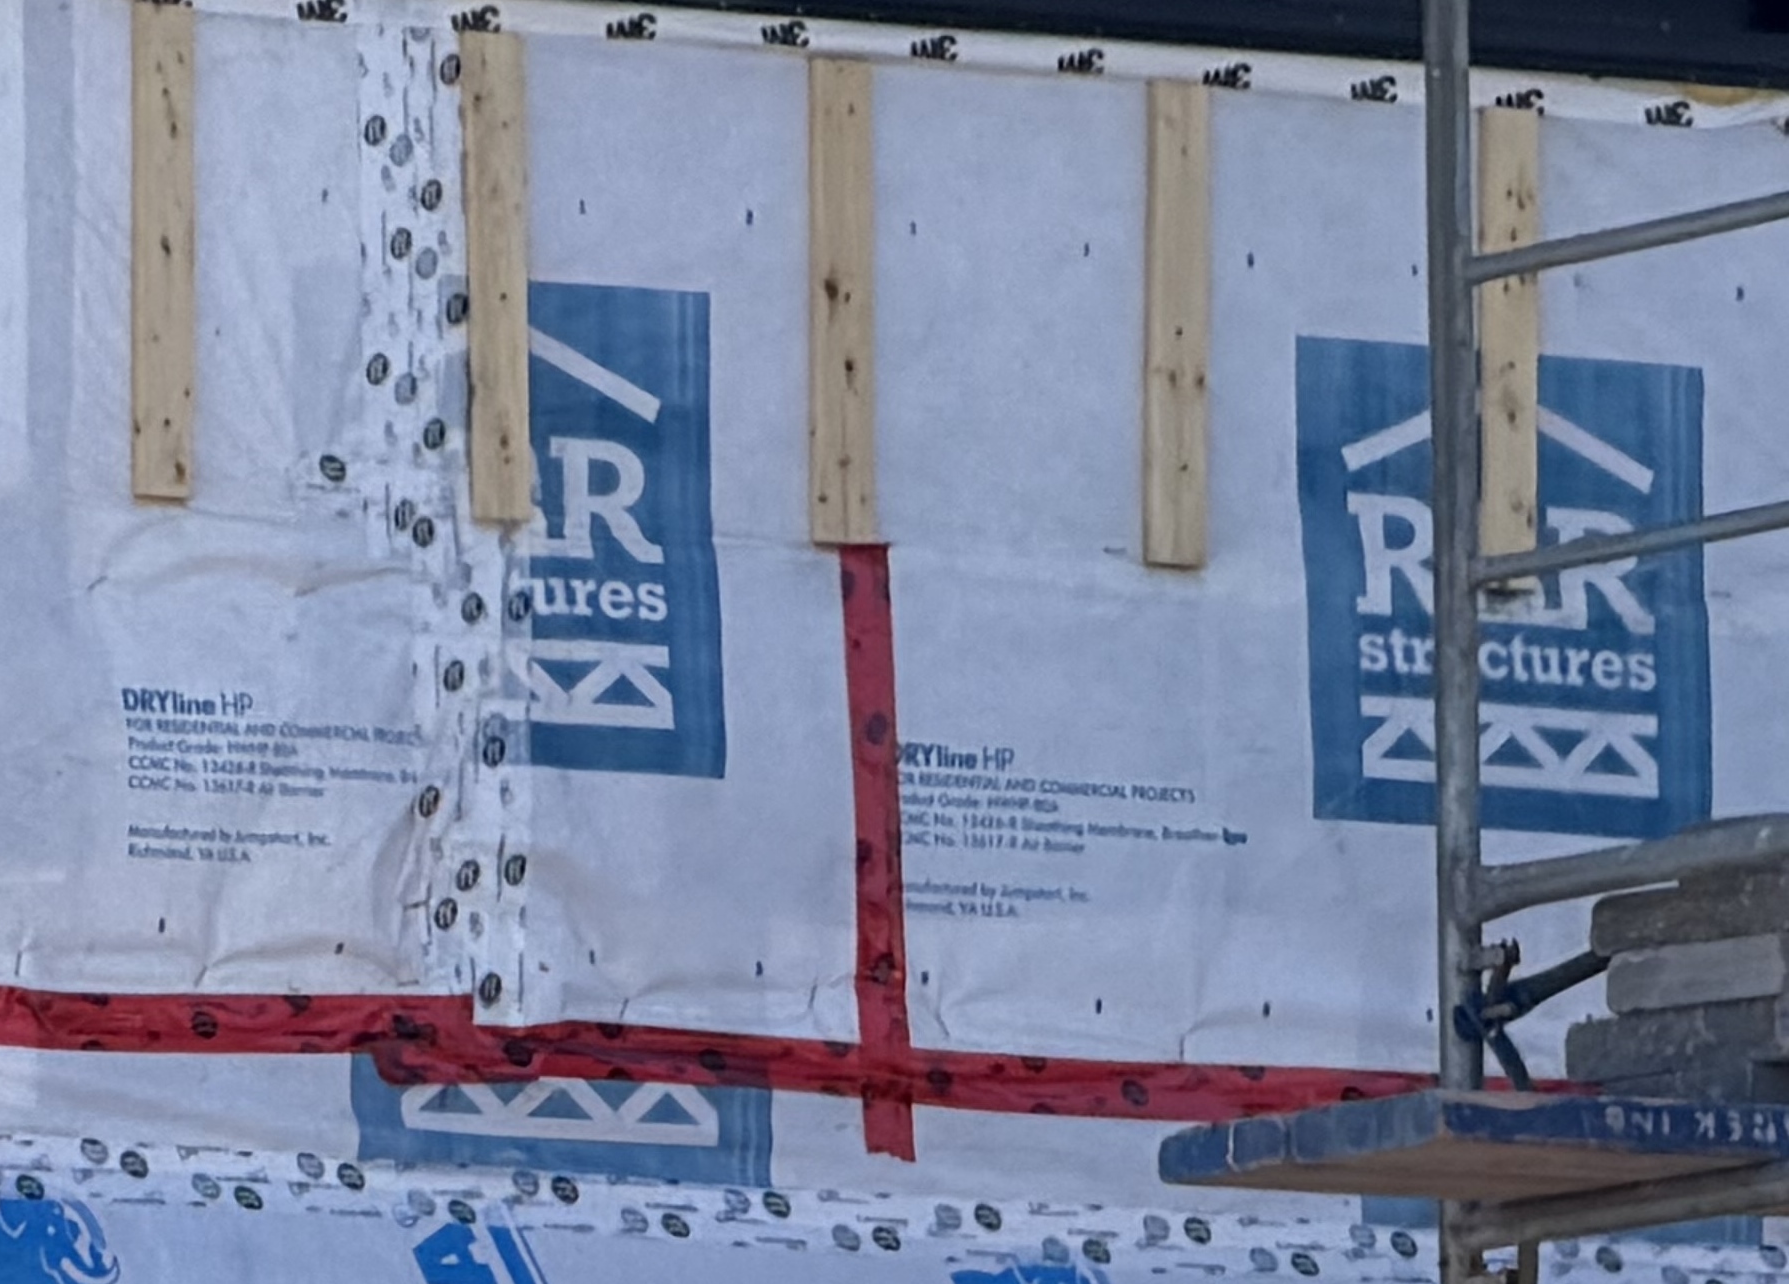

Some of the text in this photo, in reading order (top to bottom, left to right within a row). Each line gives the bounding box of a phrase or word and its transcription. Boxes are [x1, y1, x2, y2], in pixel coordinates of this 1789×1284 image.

[1347, 492, 1655, 635] RR
[1359, 628, 1657, 691] strctures
[121, 688, 254, 718] DRYline HP
[982, 746, 1016, 772] HP
